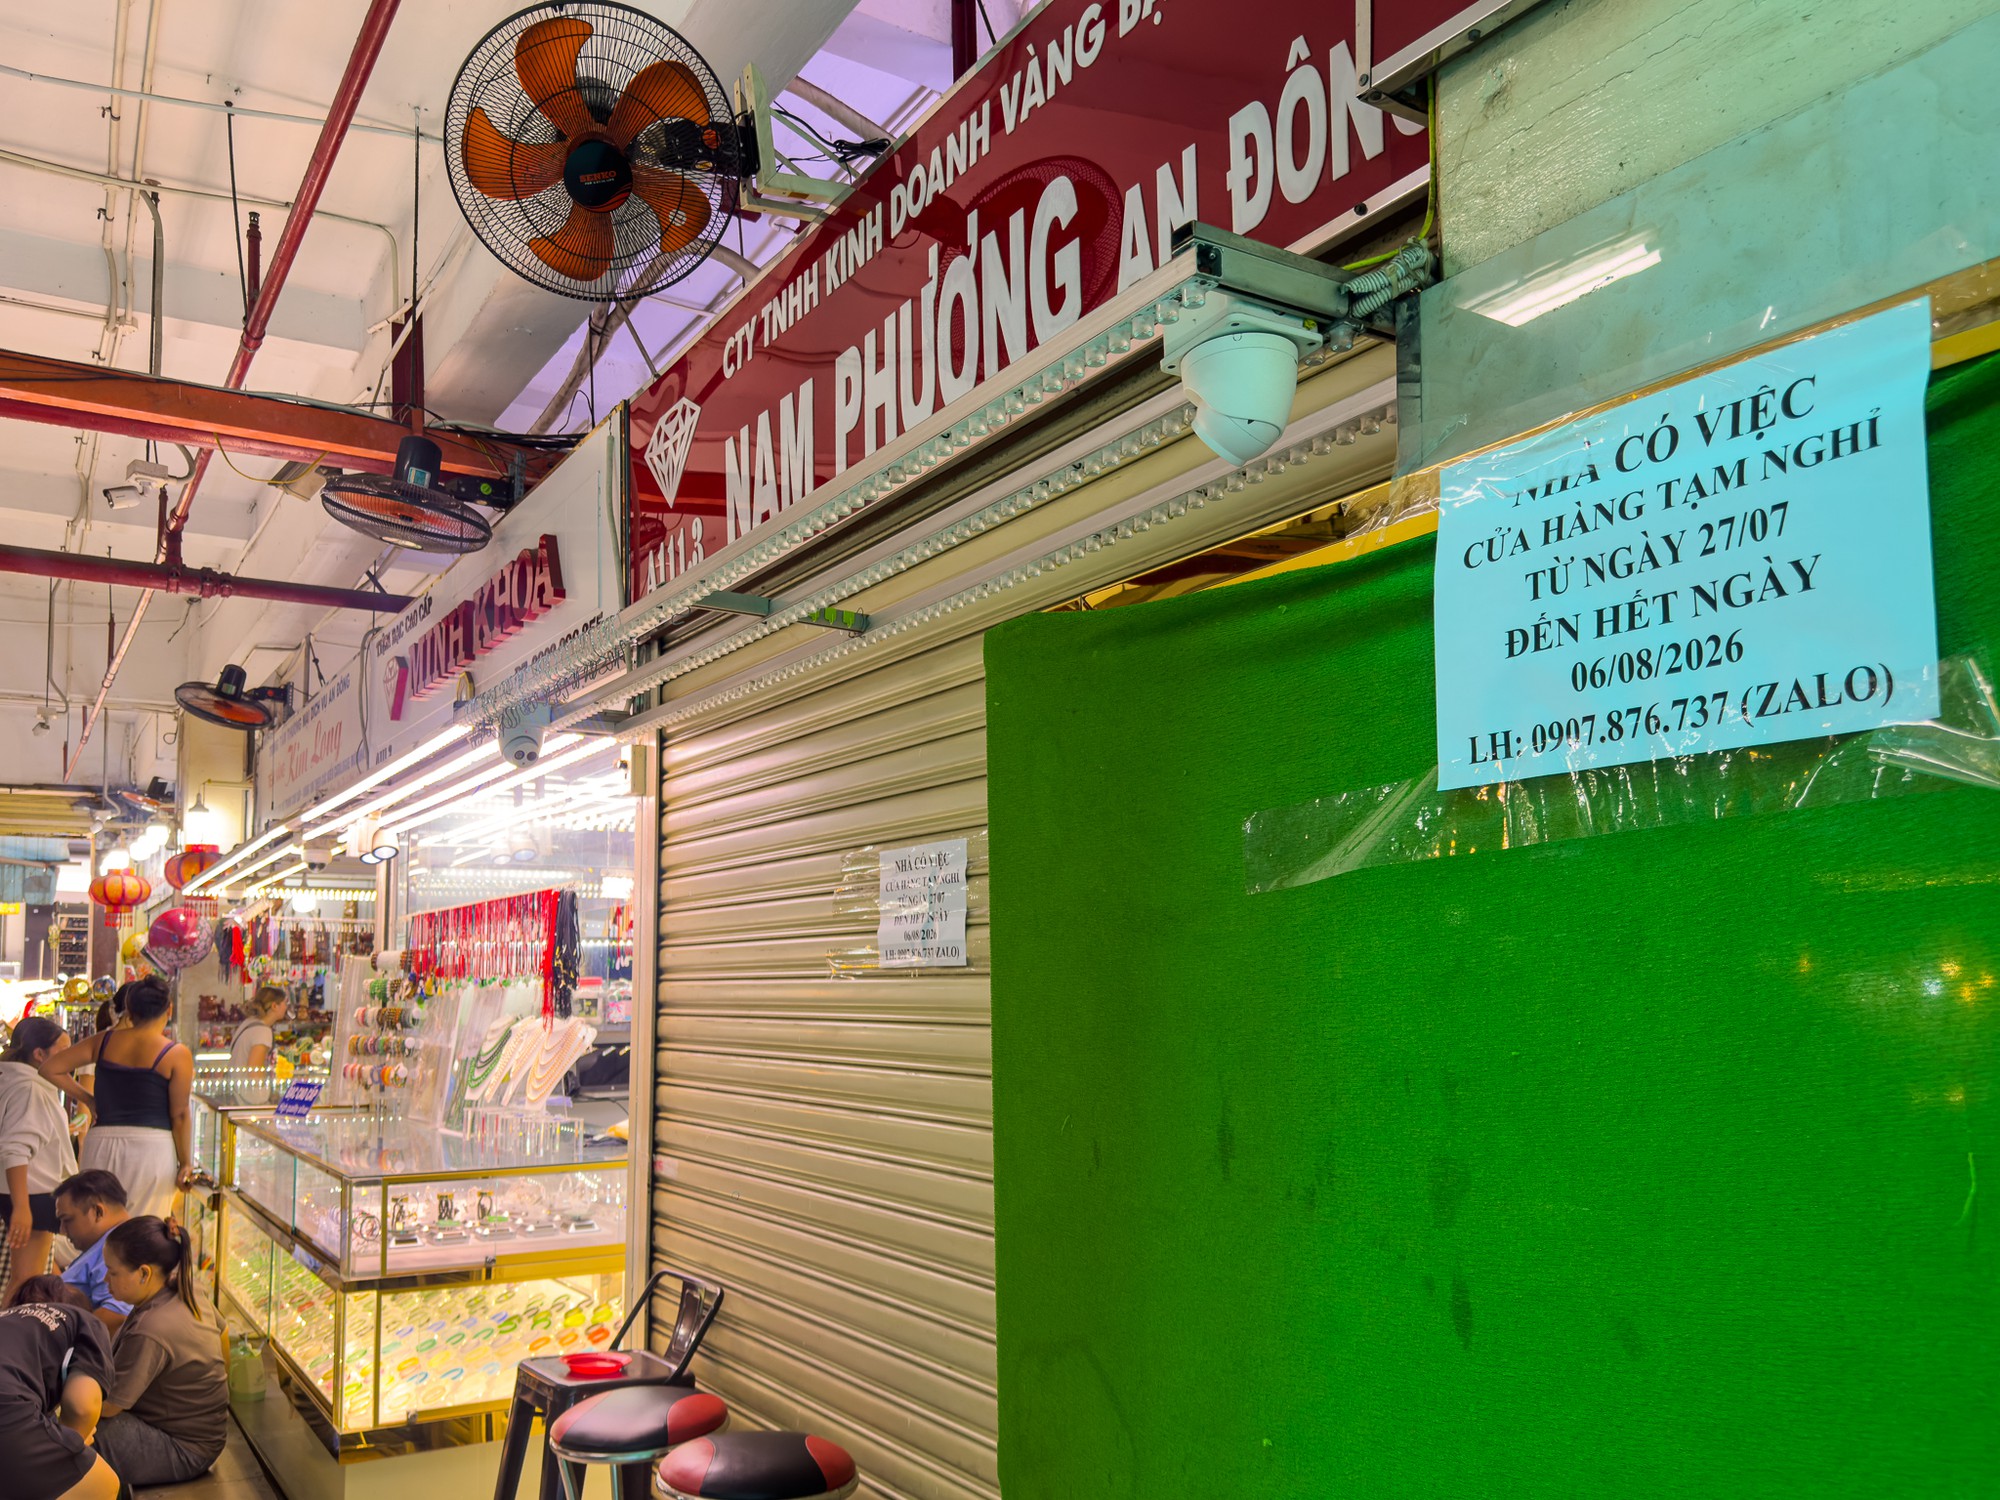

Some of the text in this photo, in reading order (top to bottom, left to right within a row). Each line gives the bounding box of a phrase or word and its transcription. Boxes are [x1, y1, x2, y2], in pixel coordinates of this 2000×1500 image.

[722, 314, 757, 379] CTY
[761, 261, 819, 348] TNHH
[826, 201, 883, 297] KINH
[891, 99, 990, 239] DOANH
[1000, 3, 1106, 136] VÀNG
[725, 35, 1426, 546] NAM PHƯƠNG AN ĐÔN
[1615, 413, 1679, 473] CÓ
[1693, 374, 1816, 448] VIỆC
[1463, 407, 1882, 569] CỬA HÀNG TẠM NGHỈ
[1525, 501, 1789, 602] TỪ NGÀY 27/07
[405, 609, 418, 633] CAO
[408, 600, 475, 696] MINH
[473, 534, 566, 655] KHOA
[1504, 554, 1822, 659] ĐẾN HẾT NGÀY
[1571, 628, 1744, 692] 06/08/2026
[285, 742, 308, 787] Kim
[311, 719, 343, 765] Long
[1468, 662, 1895, 765] LH: 0907.876.737 (ZALO)
